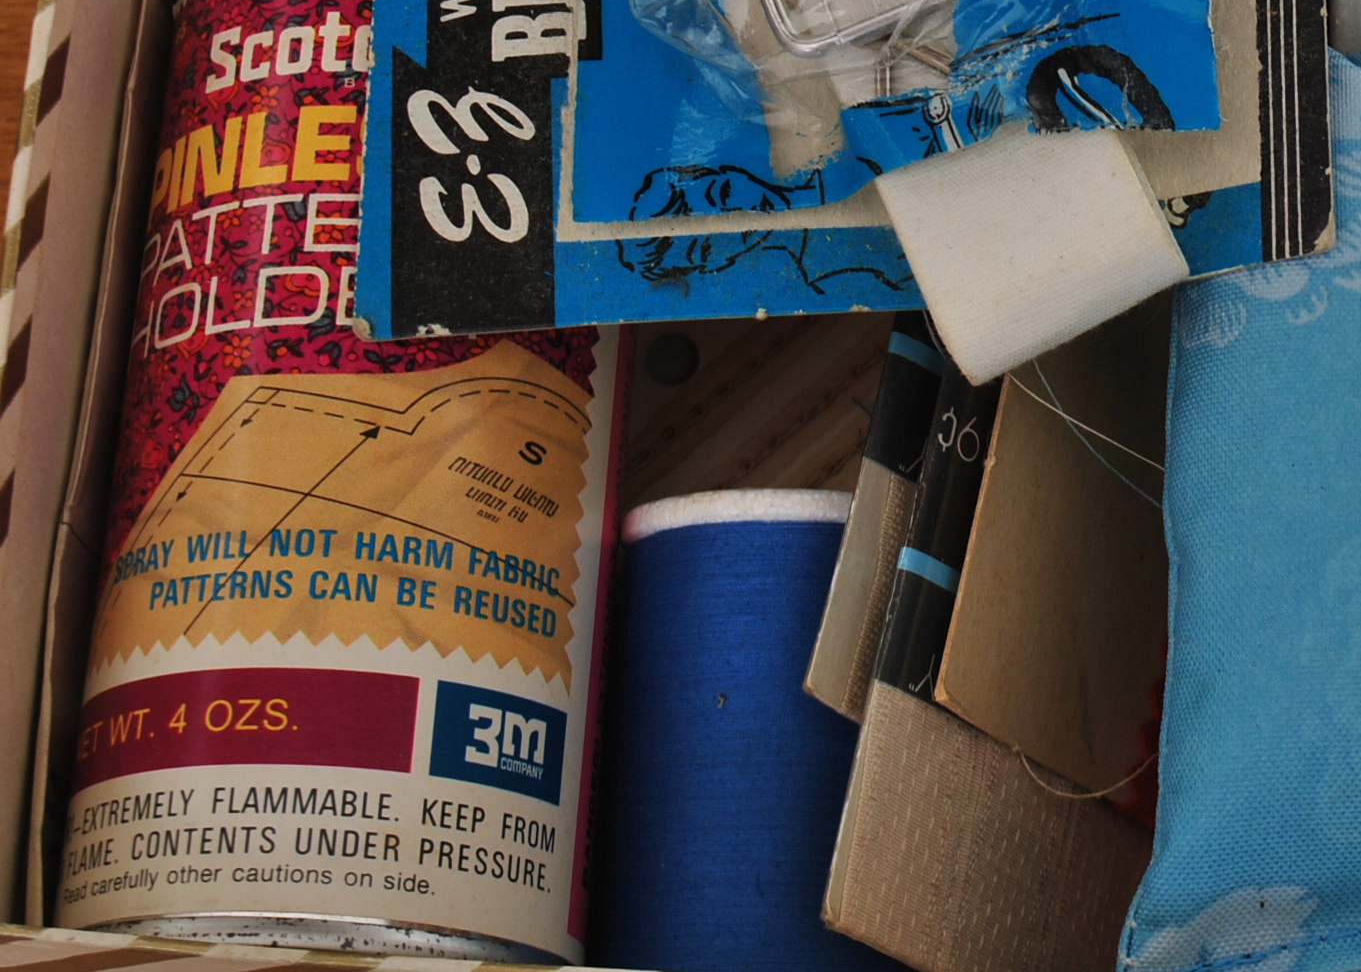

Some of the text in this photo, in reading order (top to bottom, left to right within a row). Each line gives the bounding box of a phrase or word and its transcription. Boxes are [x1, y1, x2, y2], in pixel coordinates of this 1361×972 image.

[113, 529, 561, 600] SPRAY WILL NOT HARM FABRIC
[148, 569, 557, 640] PATTERNS CAN BE REUSED
[110, 698, 300, 747] WT. 4 OZS.
[499, 755, 546, 782] COMPANY
[211, 786, 557, 855] FLAMMABLE. KEEP FROM
[67, 825, 553, 895] FLAME. CONTENTS UNDER PRESSURE.
[90, 868, 159, 902] carefully
[166, 864, 223, 886] other
[232, 863, 333, 888] cautions
[344, 870, 374, 889] on
[382, 872, 436, 897] side.
